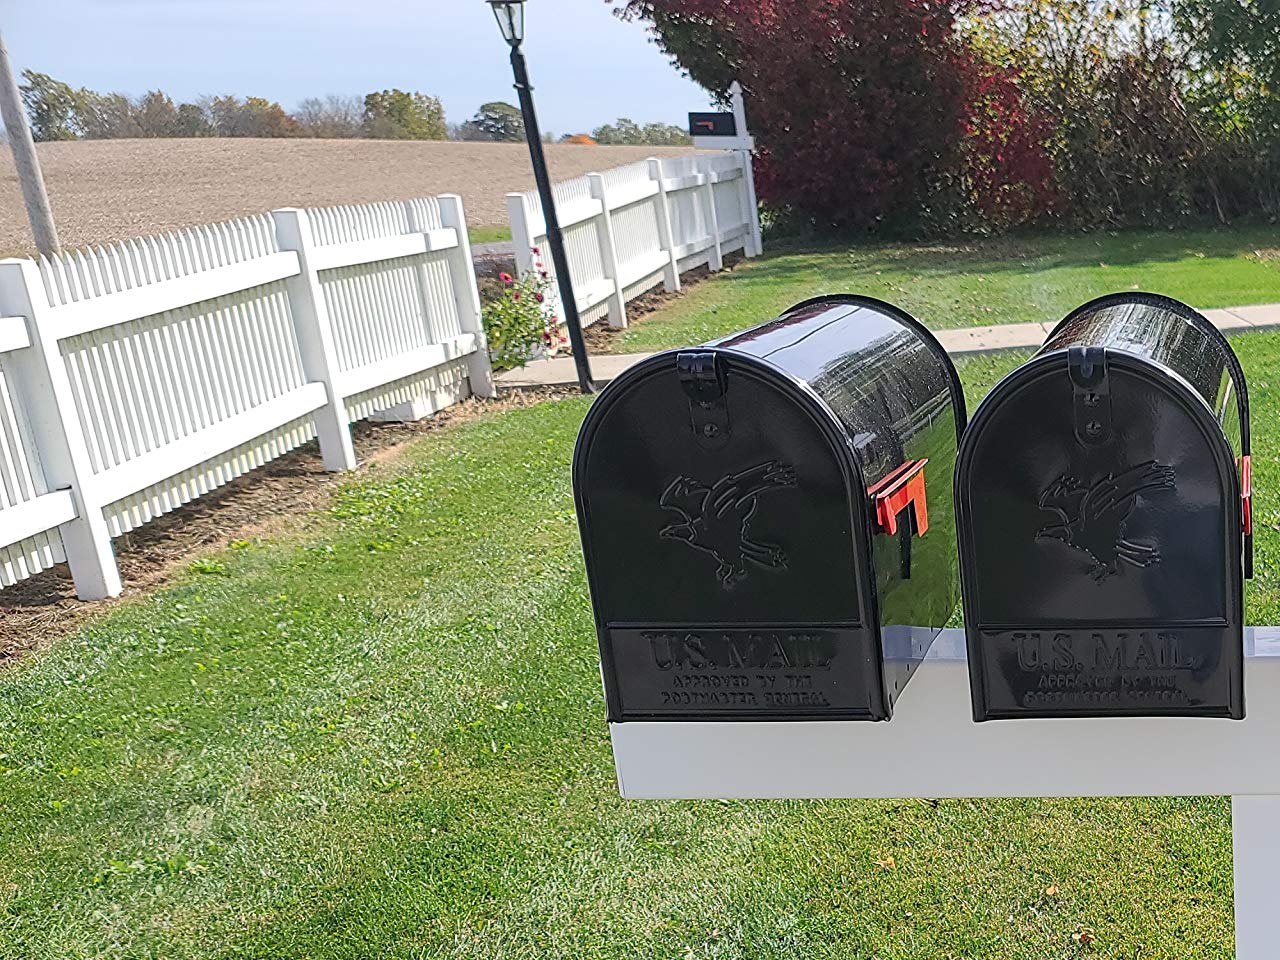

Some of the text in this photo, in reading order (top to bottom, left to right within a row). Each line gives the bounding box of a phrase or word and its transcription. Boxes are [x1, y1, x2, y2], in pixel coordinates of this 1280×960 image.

[640, 632, 833, 671] U.S. MAIL
[1011, 632, 1195, 672] U.S. MAIL
[672, 674, 750, 689] APPROVED
